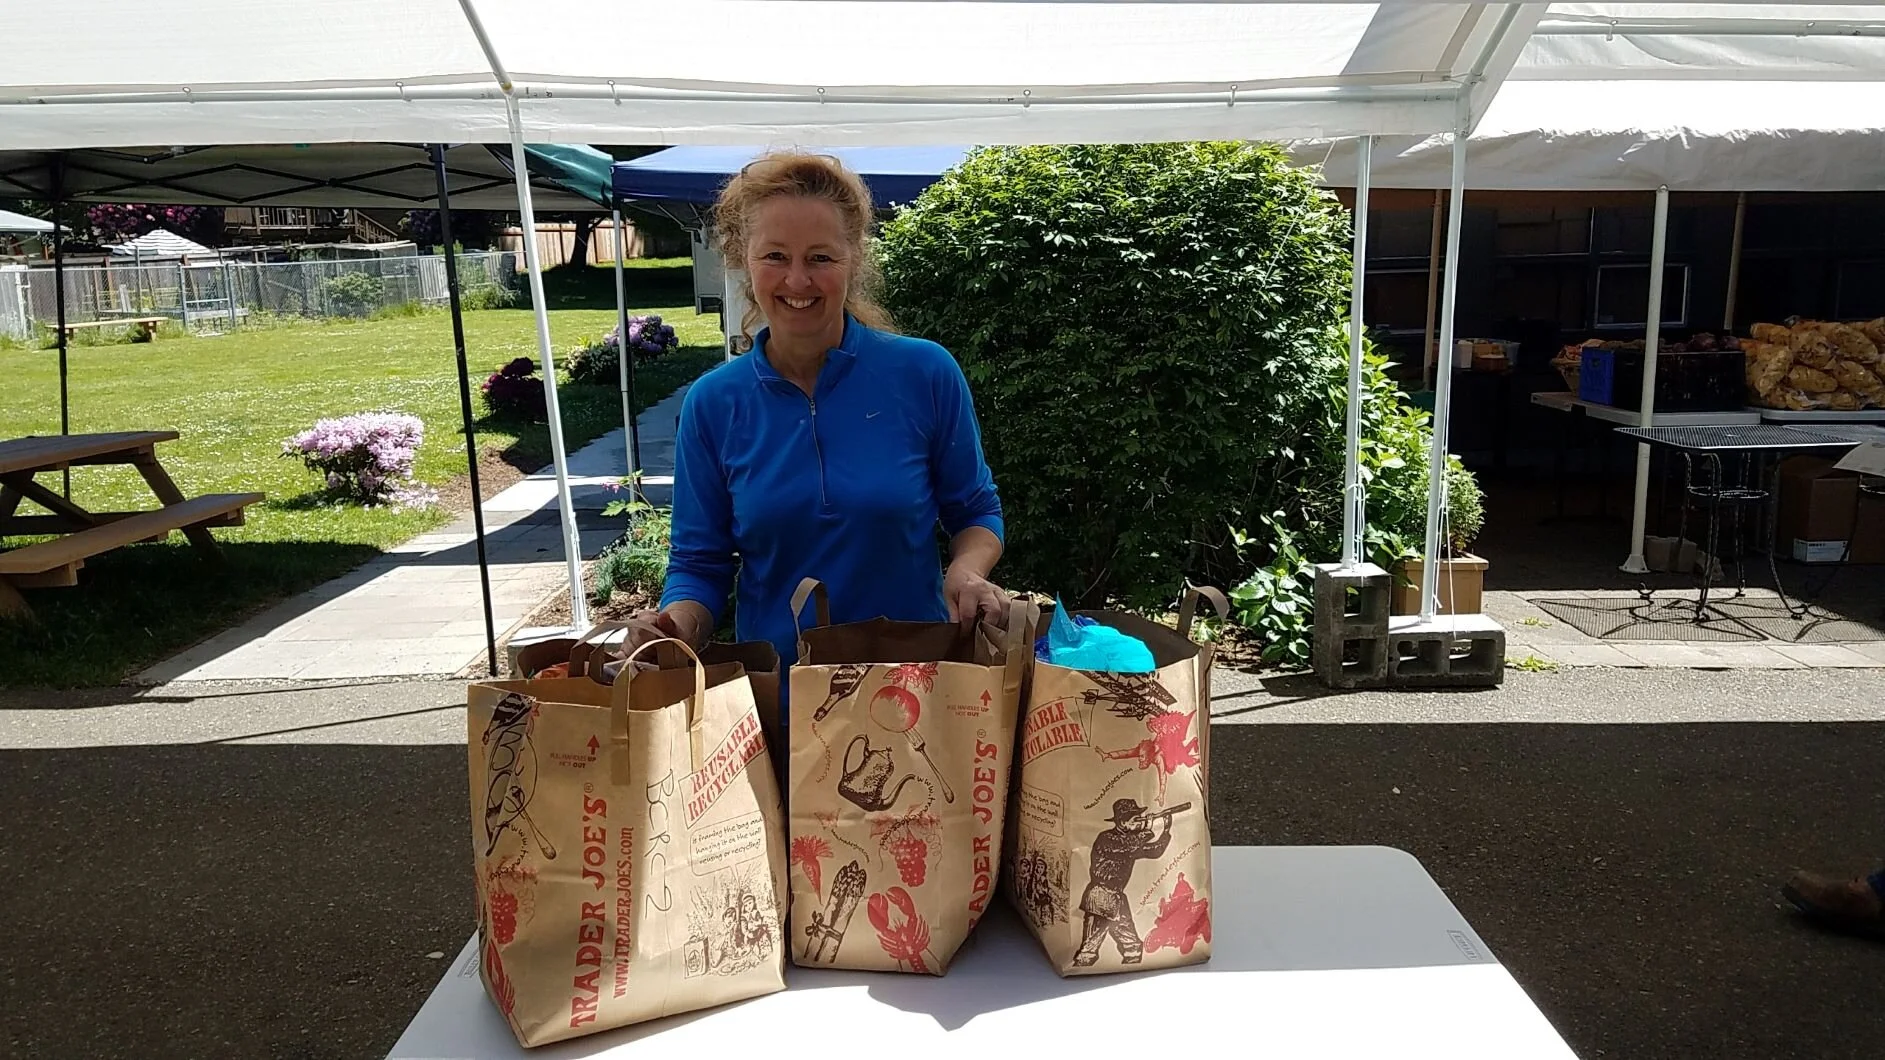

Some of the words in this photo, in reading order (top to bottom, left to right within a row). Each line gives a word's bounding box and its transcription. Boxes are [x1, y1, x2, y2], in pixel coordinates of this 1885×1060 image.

[690, 712, 758, 794] REUSABLE
[723, 825, 736, 834] the
[735, 821, 750, 830] bag
[750, 815, 763, 825] and
[736, 832, 749, 841] the
[748, 826, 762, 837] wall
[699, 853, 723, 864] reusing
[569, 900, 606, 1029] TRADER
